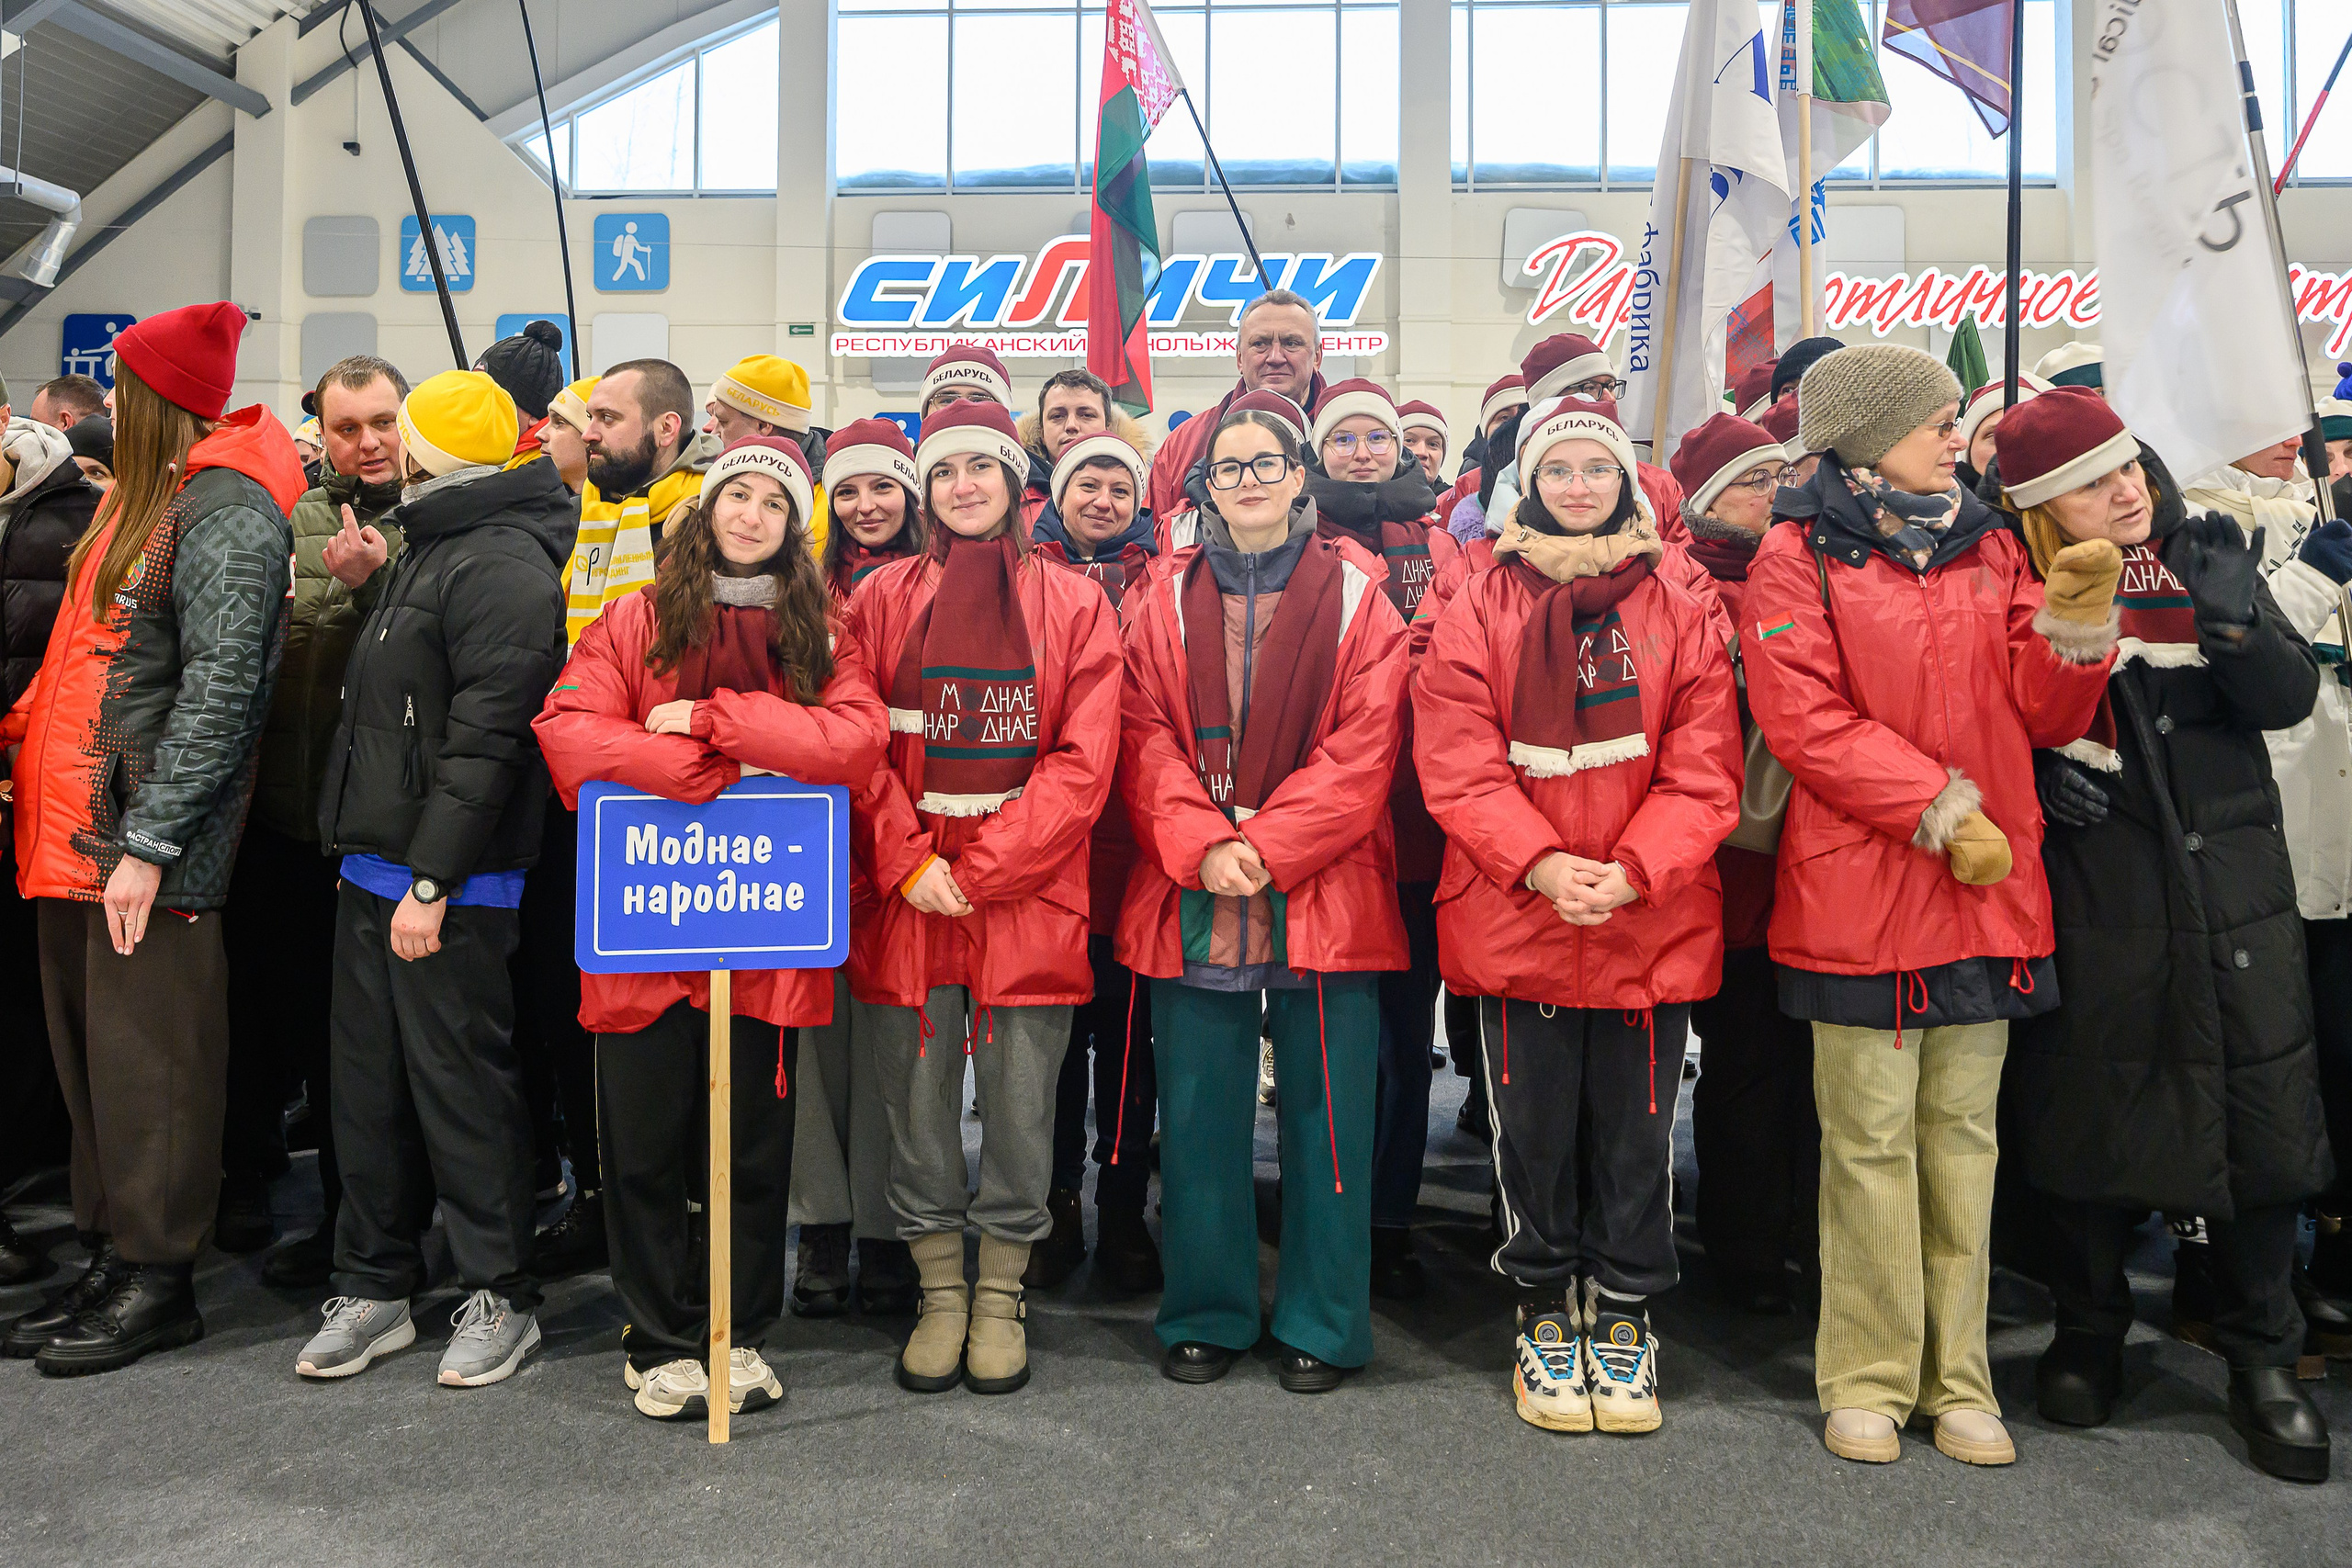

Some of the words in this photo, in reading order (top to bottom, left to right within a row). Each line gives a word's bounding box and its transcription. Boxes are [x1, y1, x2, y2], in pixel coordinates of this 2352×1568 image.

[1322, 337, 1382, 350] ЕНТР
[933, 368, 992, 385] БЕЛАРУСЬ
[727, 387, 780, 416] БЕЛАРУСЬ
[1547, 419, 1619, 441] БЕЛАРУСЬ
[722, 454, 792, 478] БЕЛАРУСЬ
[115, 592, 137, 609] ARUS
[625, 822, 773, 865] Моднае
[623, 869, 805, 927] народнае
